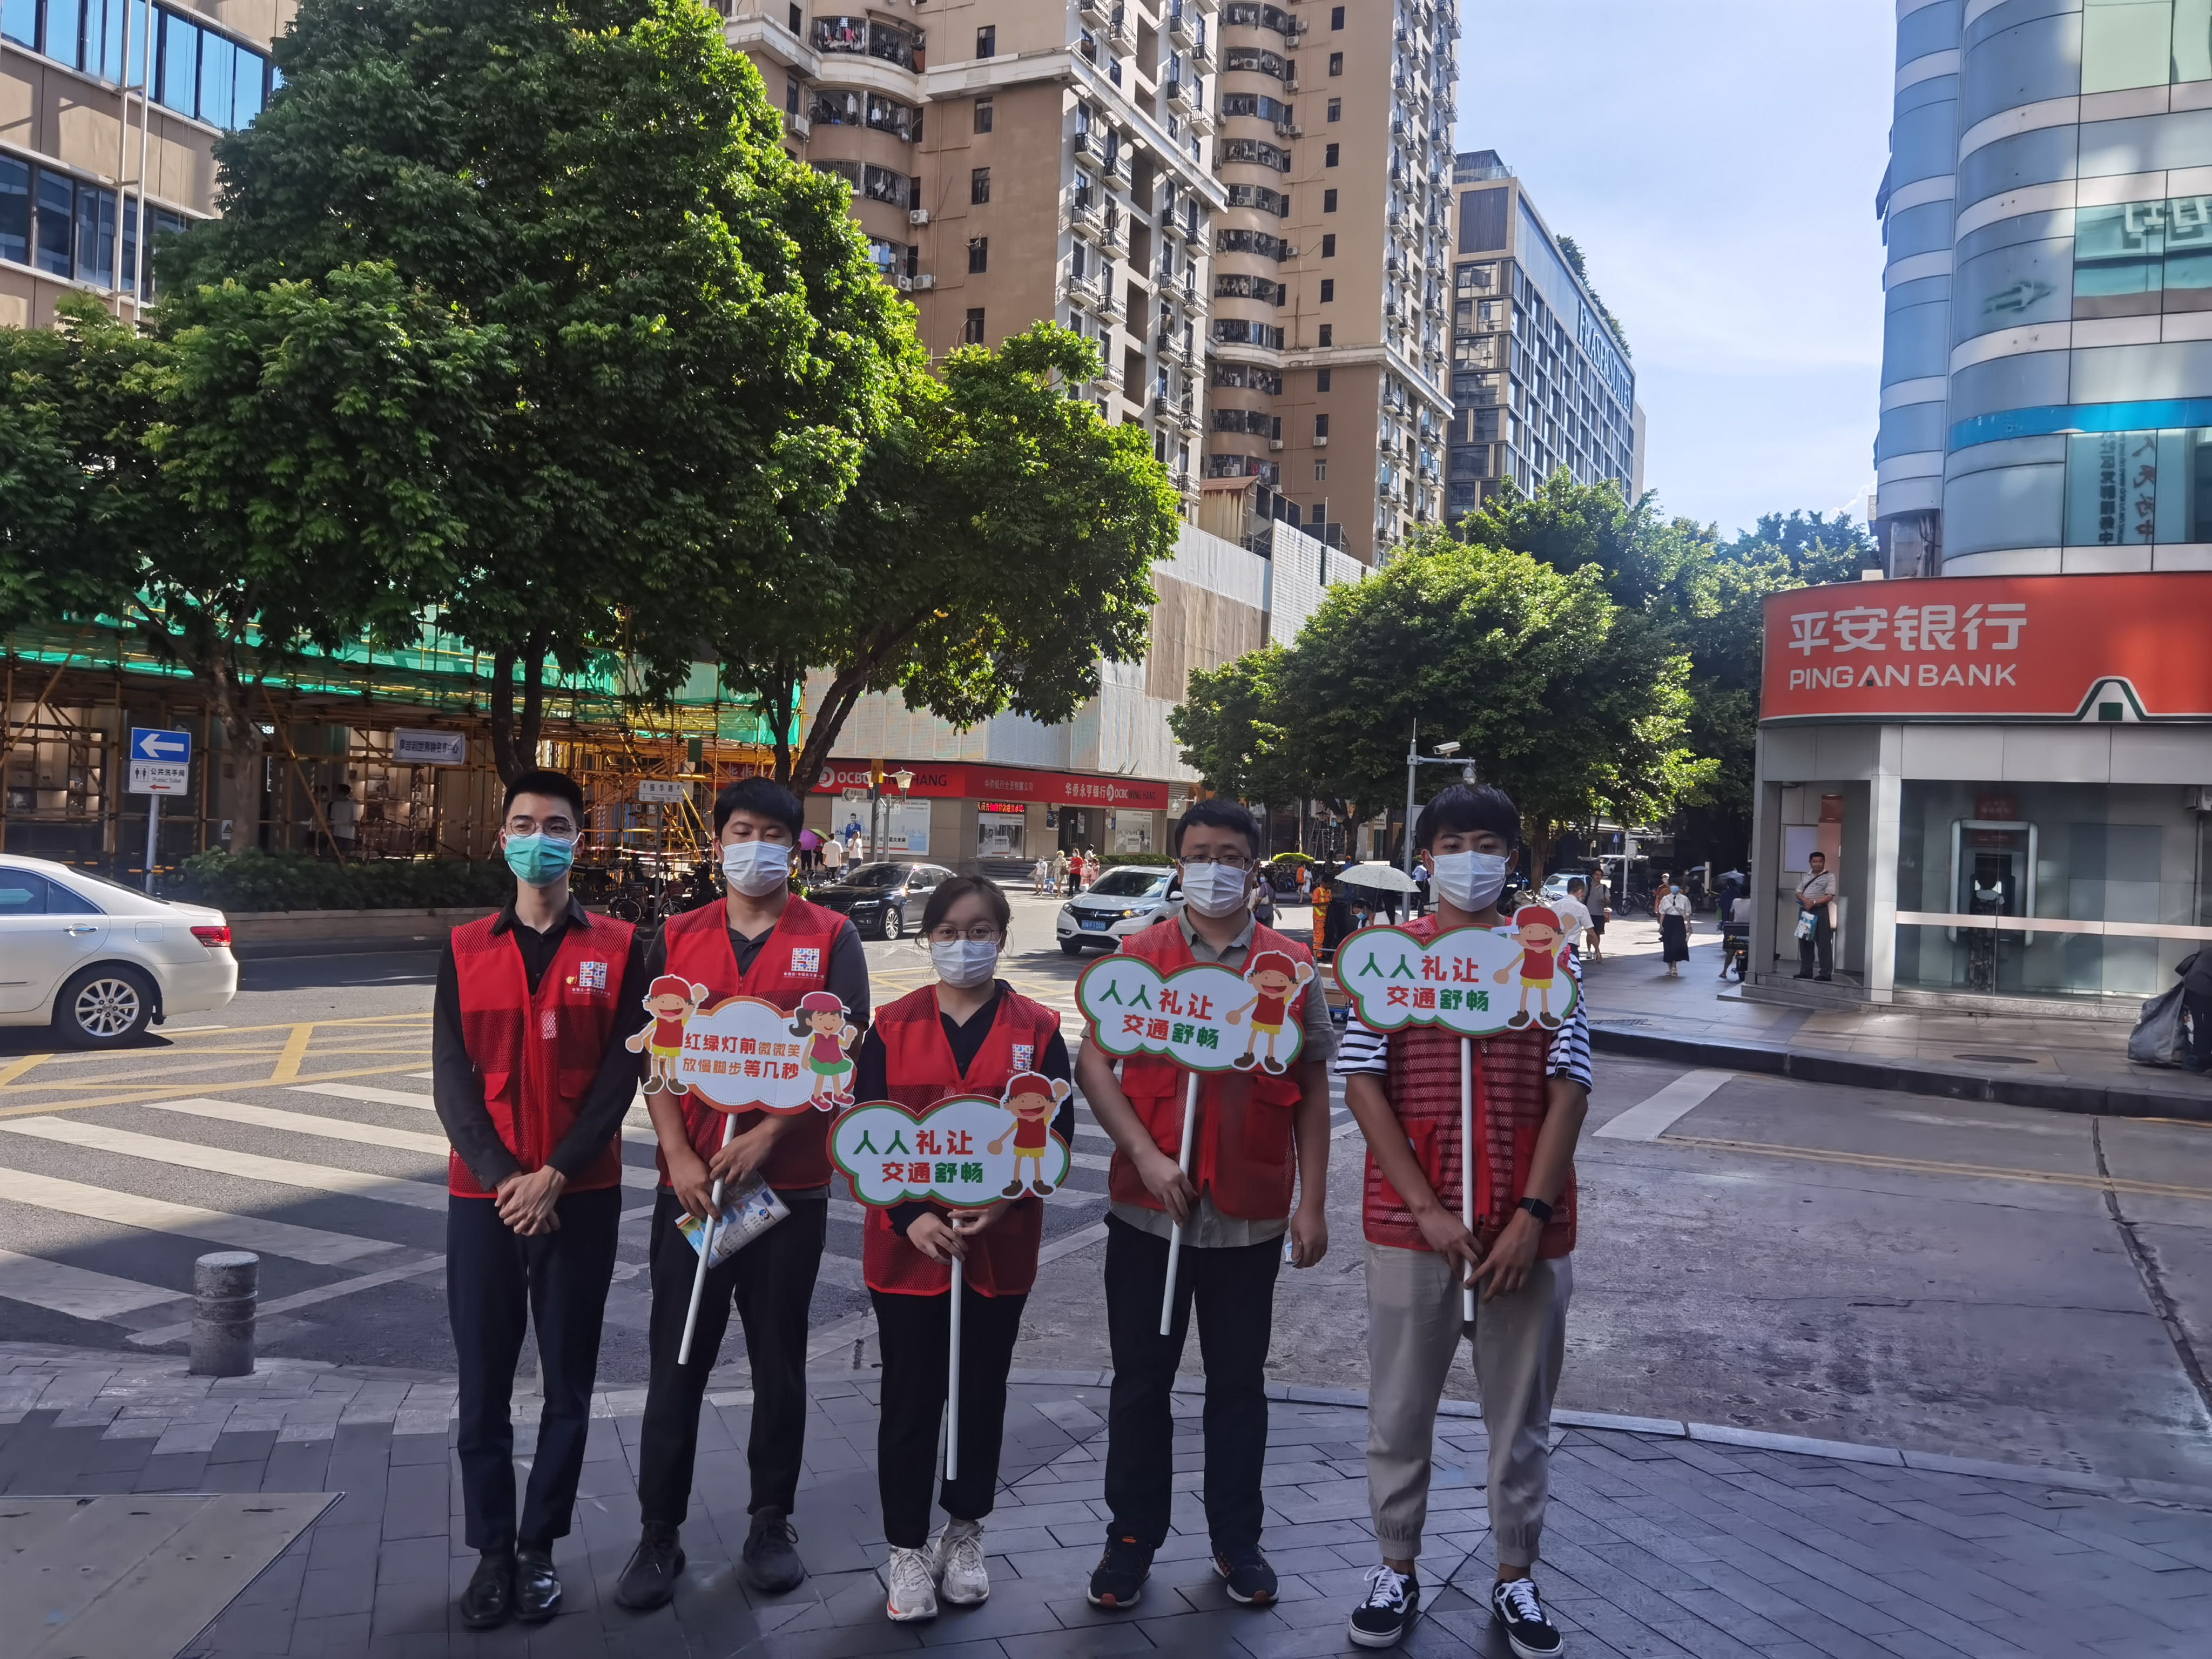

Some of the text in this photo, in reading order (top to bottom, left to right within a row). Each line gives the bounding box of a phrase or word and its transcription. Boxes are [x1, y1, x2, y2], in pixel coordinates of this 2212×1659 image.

[1578, 299, 1631, 414] FRASER SUITES
[1789, 603, 2027, 656] 平安银行
[1918, 663, 2016, 686] BANK
[151, 768, 185, 777] 公共洗手间
[912, 775, 947, 786] HANG
[1065, 783, 1106, 798] 华侨永亨银行
[1115, 788, 1156, 800] OCBC WING HANG
[1358, 952, 1479, 983] 人人礼让
[1098, 979, 1213, 1021] 人人礼让
[1387, 986, 1489, 1012] 交通舒畅
[1122, 1014, 1219, 1050] 交通舒畅
[684, 1033, 800, 1058] 红绿灯前微微笑
[683, 1057, 799, 1080] 放慢脚步等几秒
[853, 1130, 973, 1155] 人人礼让
[882, 1162, 983, 1184] 交通舒畅
